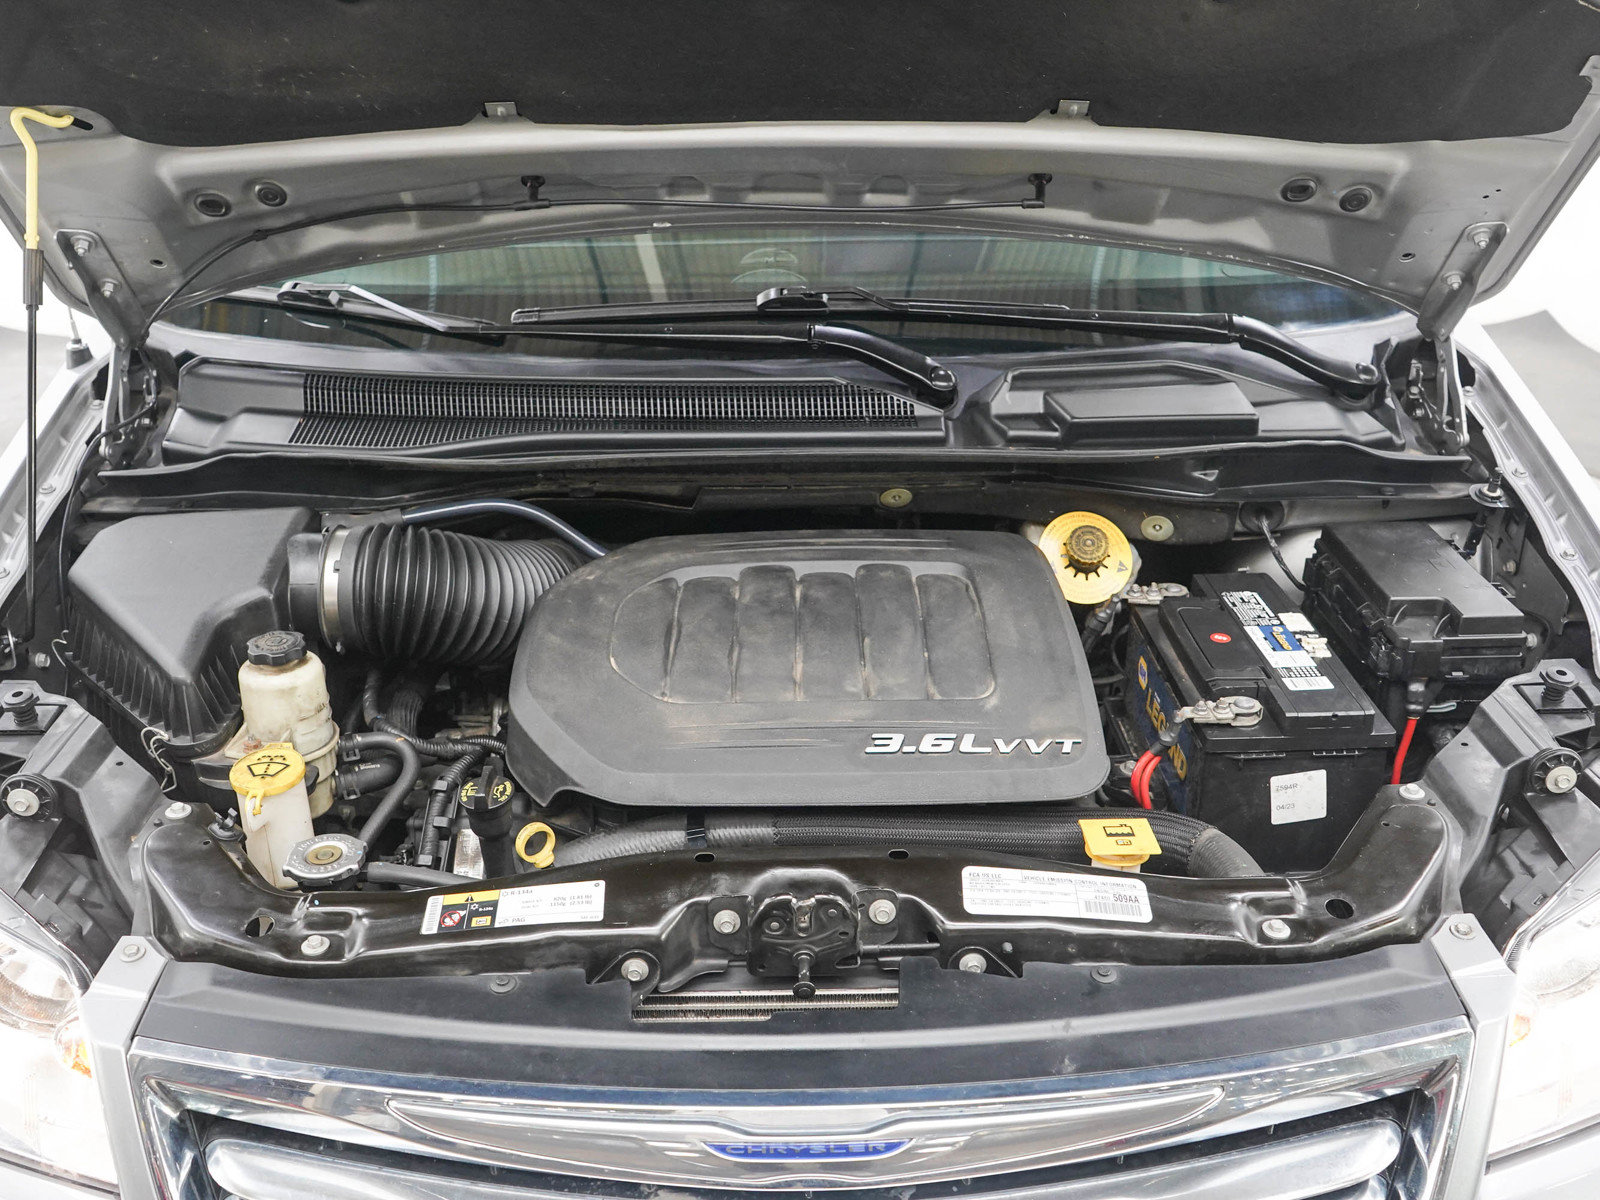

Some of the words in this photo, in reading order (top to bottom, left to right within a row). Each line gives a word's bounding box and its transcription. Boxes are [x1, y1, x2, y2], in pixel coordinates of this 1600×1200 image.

[1145, 687, 1187, 781] LEGND
[865, 733, 992, 754] 3.6L
[993, 738, 1083, 755] VVT
[1112, 893, 1140, 903] 509AA
[725, 1141, 886, 1155] CHRYSLER
